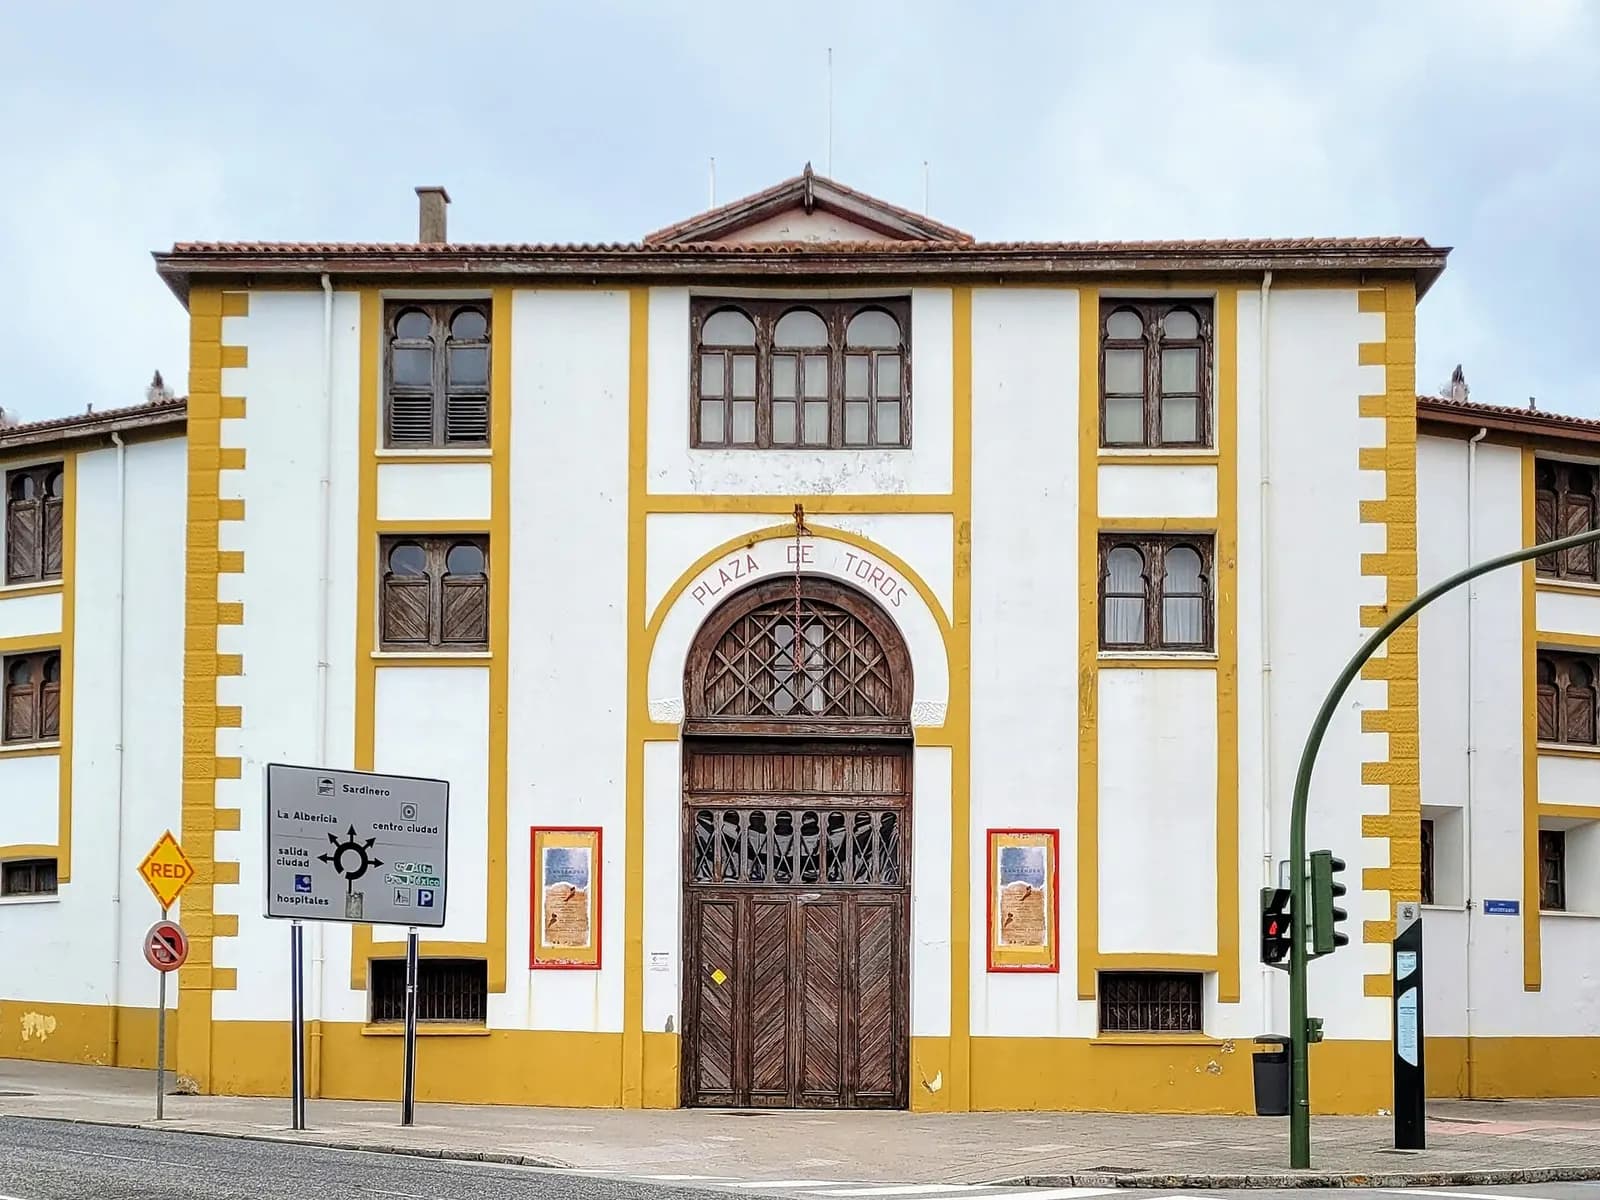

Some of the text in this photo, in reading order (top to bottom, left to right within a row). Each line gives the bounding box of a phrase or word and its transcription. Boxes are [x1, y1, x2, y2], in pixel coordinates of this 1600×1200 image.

[691, 545, 908, 608] PLAZA DE TOROS
[342, 784, 390, 797] Sardinero
[277, 809, 337, 823] La Albericia
[372, 822, 438, 834] centro ciudad
[278, 847, 309, 857] salida
[276, 857, 310, 868] ciudad
[151, 863, 185, 879] RED
[276, 894, 329, 906] hospitales
[421, 891, 432, 905] P
